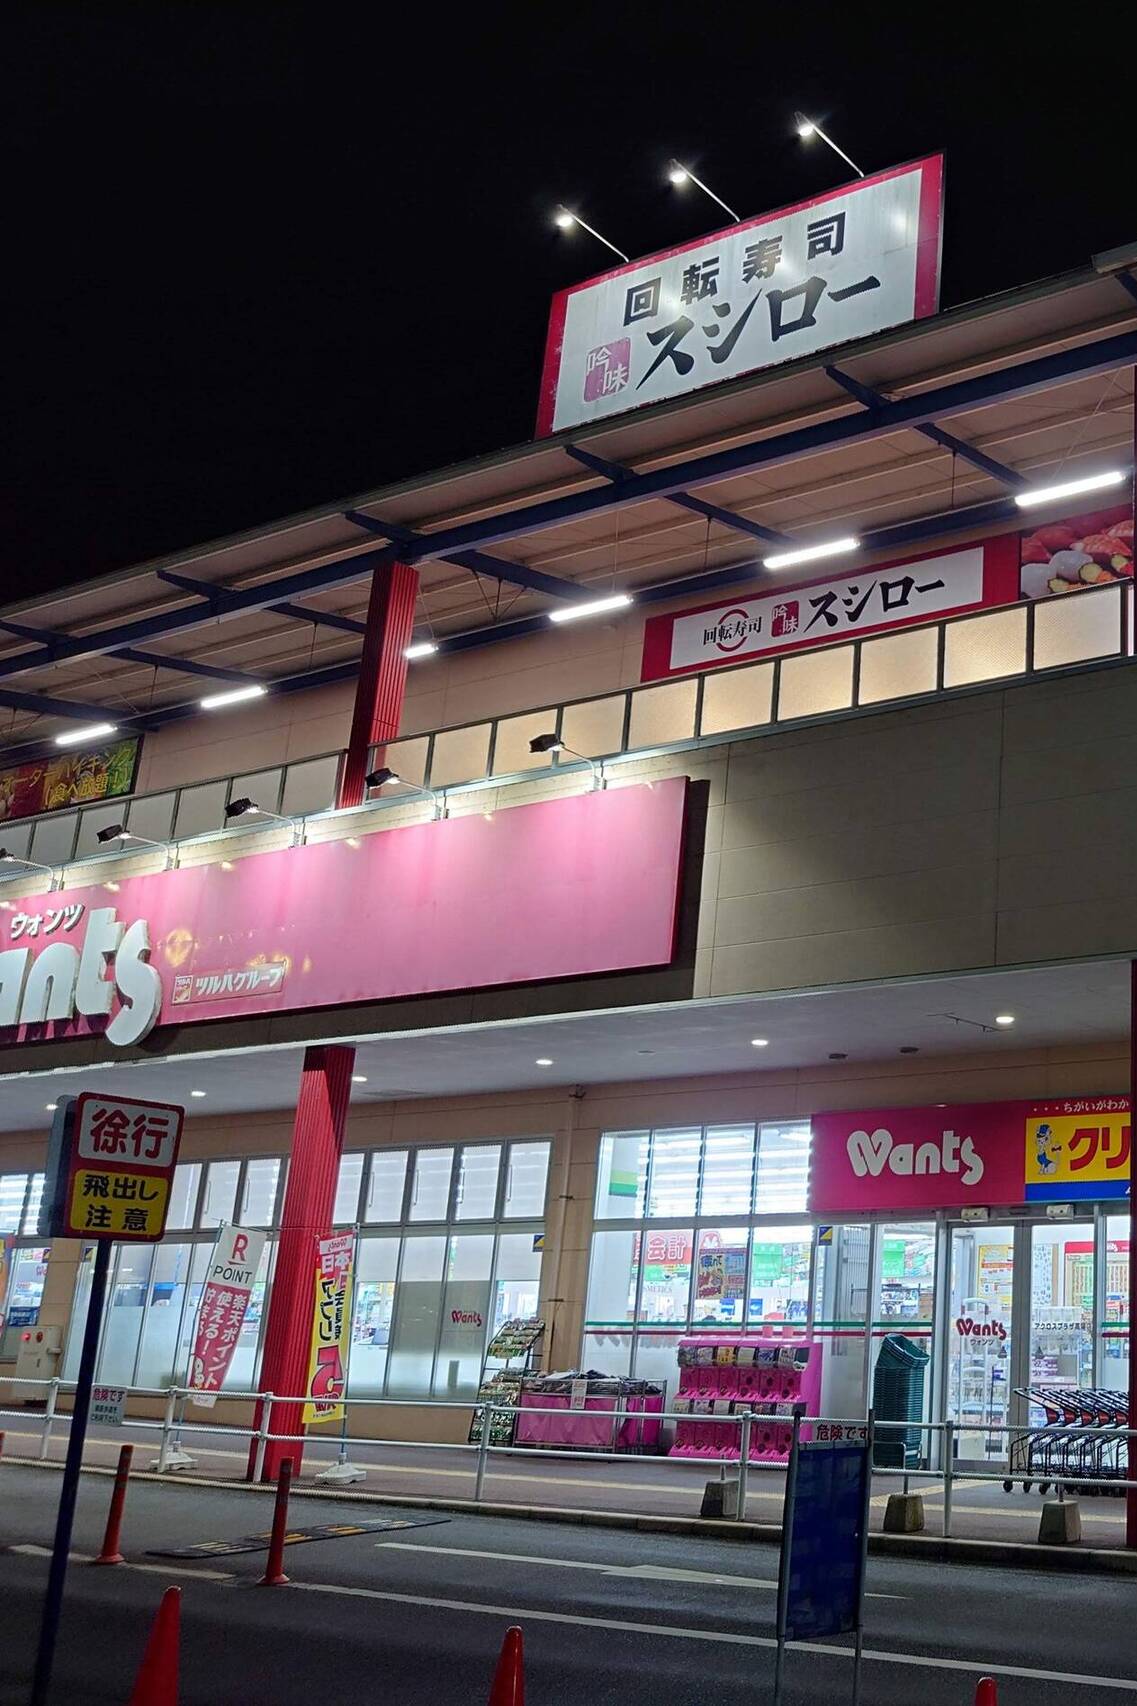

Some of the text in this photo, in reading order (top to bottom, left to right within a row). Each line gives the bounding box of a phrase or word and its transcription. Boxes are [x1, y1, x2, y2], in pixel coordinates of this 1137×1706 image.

[623, 211, 847, 327] 回転寿司
[635, 275, 881, 391] スシロー
[585, 345, 630, 396] 吟味
[773, 604, 799, 635] 吟味
[804, 574, 945, 634] スシロー
[703, 615, 763, 646] 回転寿司
[10, 903, 85, 940] ウォンツ
[195, 960, 285, 996] ツルハグループ
[90, 1107, 168, 1159] 徐行
[846, 1128, 985, 1186] Wants
[82, 1174, 159, 1202] 飛出し
[84, 1203, 149, 1232] 注意
[212, 1265, 253, 1284] POINT
[451, 1308, 482, 1328] Wants
[955, 1317, 1008, 1341] Wants
[205, 1293, 245, 1389] 楽天ポイント
[969, 1338, 995, 1346] ウォンツ
[816, 1423, 869, 1441] 危険です
